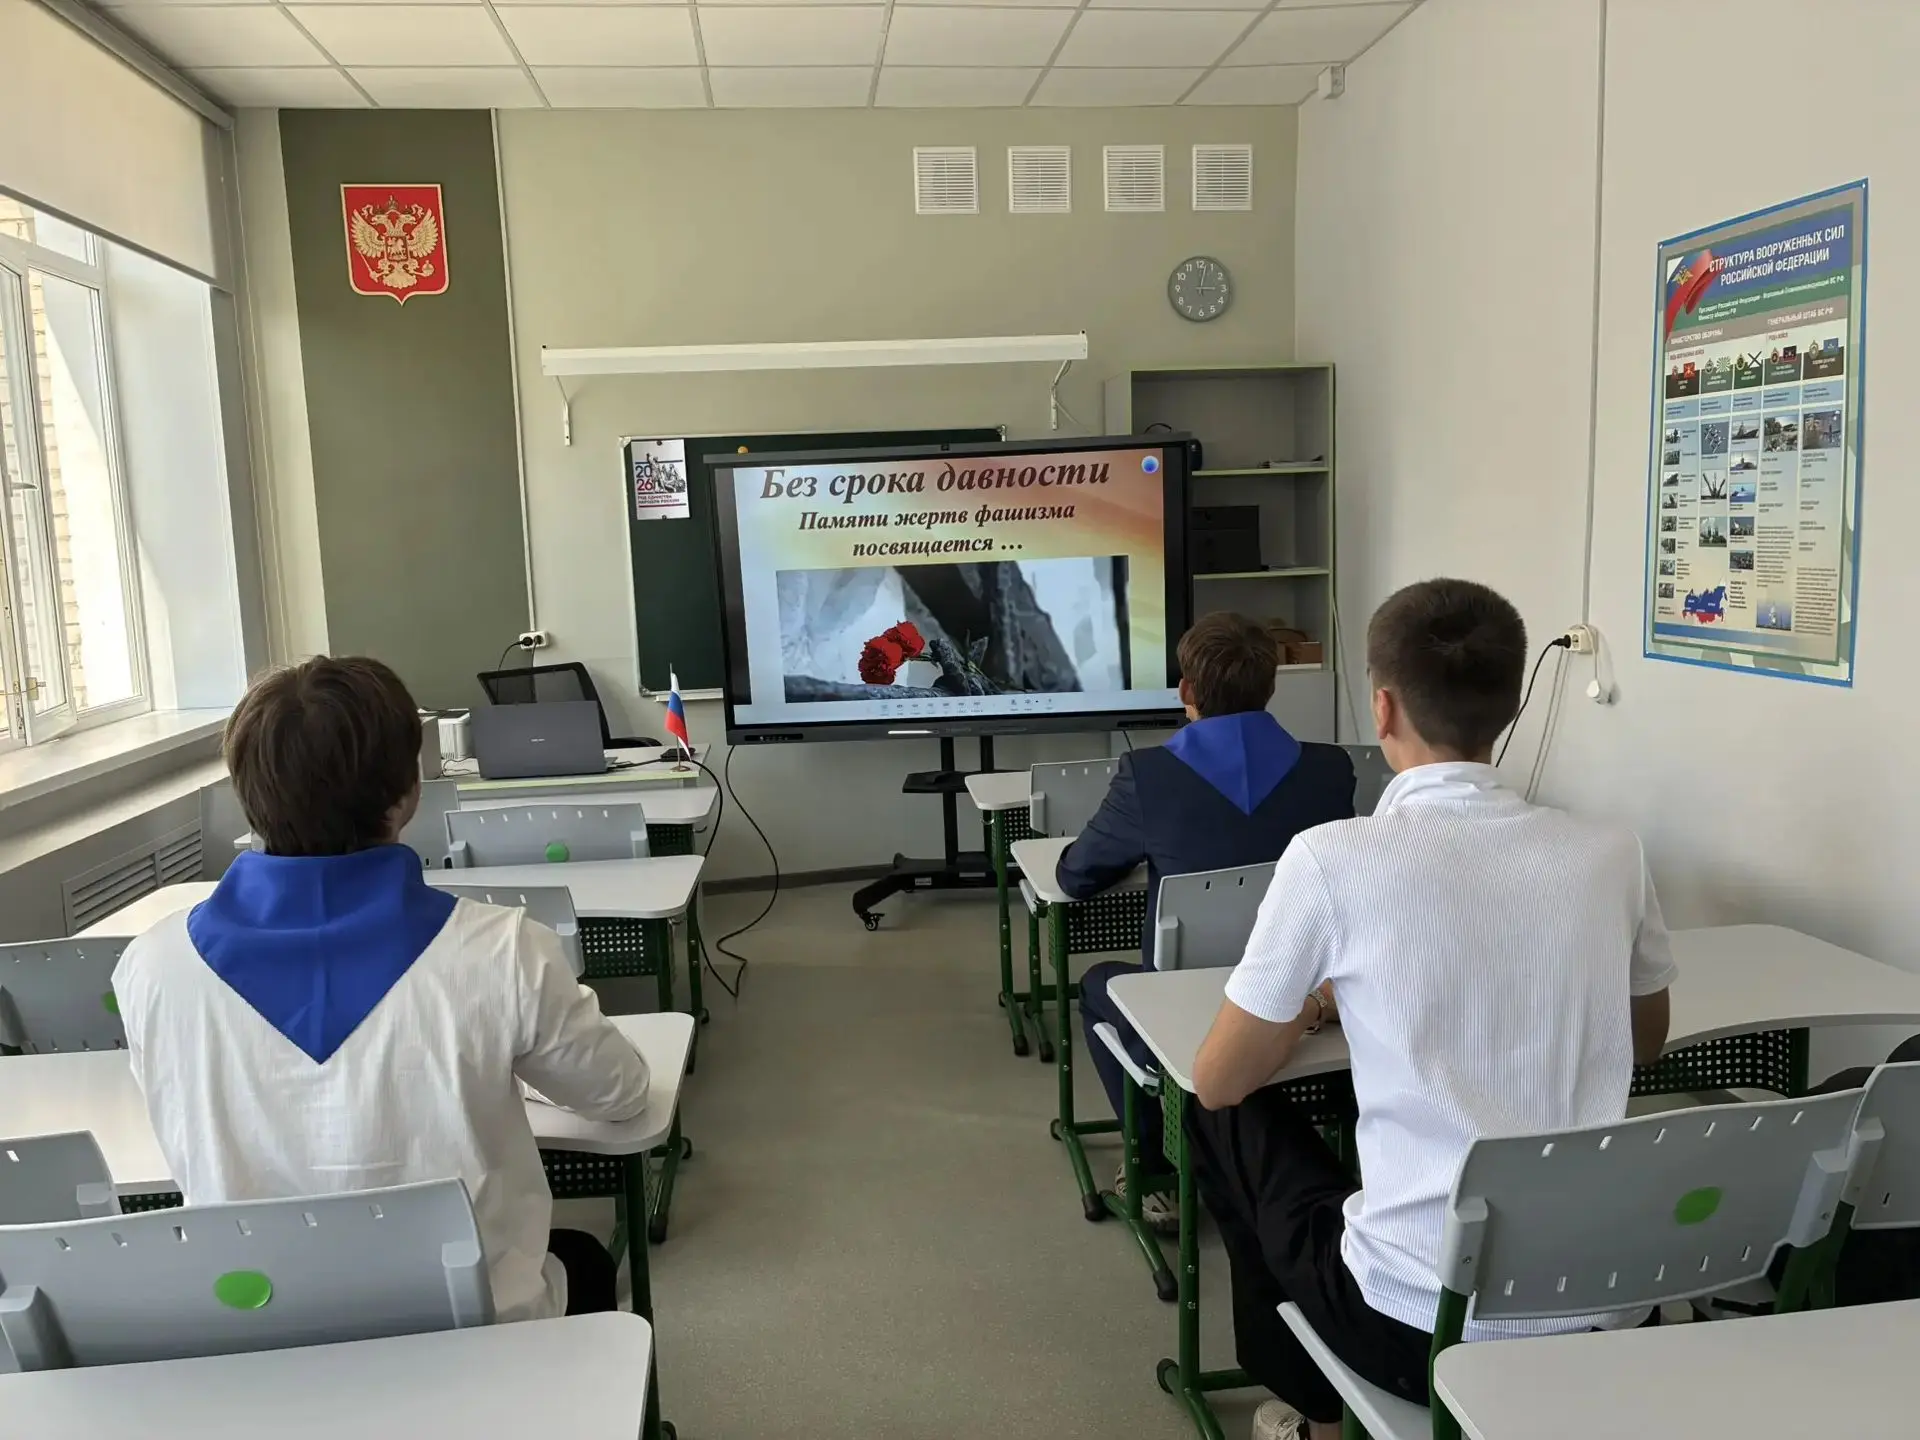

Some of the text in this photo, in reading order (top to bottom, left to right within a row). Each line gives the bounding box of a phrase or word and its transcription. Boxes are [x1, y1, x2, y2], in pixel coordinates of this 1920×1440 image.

[1709, 224, 1845, 273] СТРУКТУРА ВООРУЖЕННЫХ СИЛ
[1185, 264, 1192, 272] 11
[1196, 260, 1205, 269] 12
[1210, 263, 1214, 271] 1
[1720, 248, 1830, 286] РОССИЙСКОЙ ФЕДЕРАЦИИ
[1176, 273, 1186, 281] 10
[1221, 284, 1227, 293] 3
[1178, 296, 1184, 305] 8
[1217, 296, 1224, 304] 4
[1198, 308, 1204, 317] 6
[1209, 305, 1216, 313] 5
[635, 465, 652, 478] 20
[636, 478, 653, 491] 26
[760, 461, 1110, 504] Без срока давности
[798, 503, 1075, 531] Памяти жертв фашизма
[852, 535, 994, 558] посвящается
